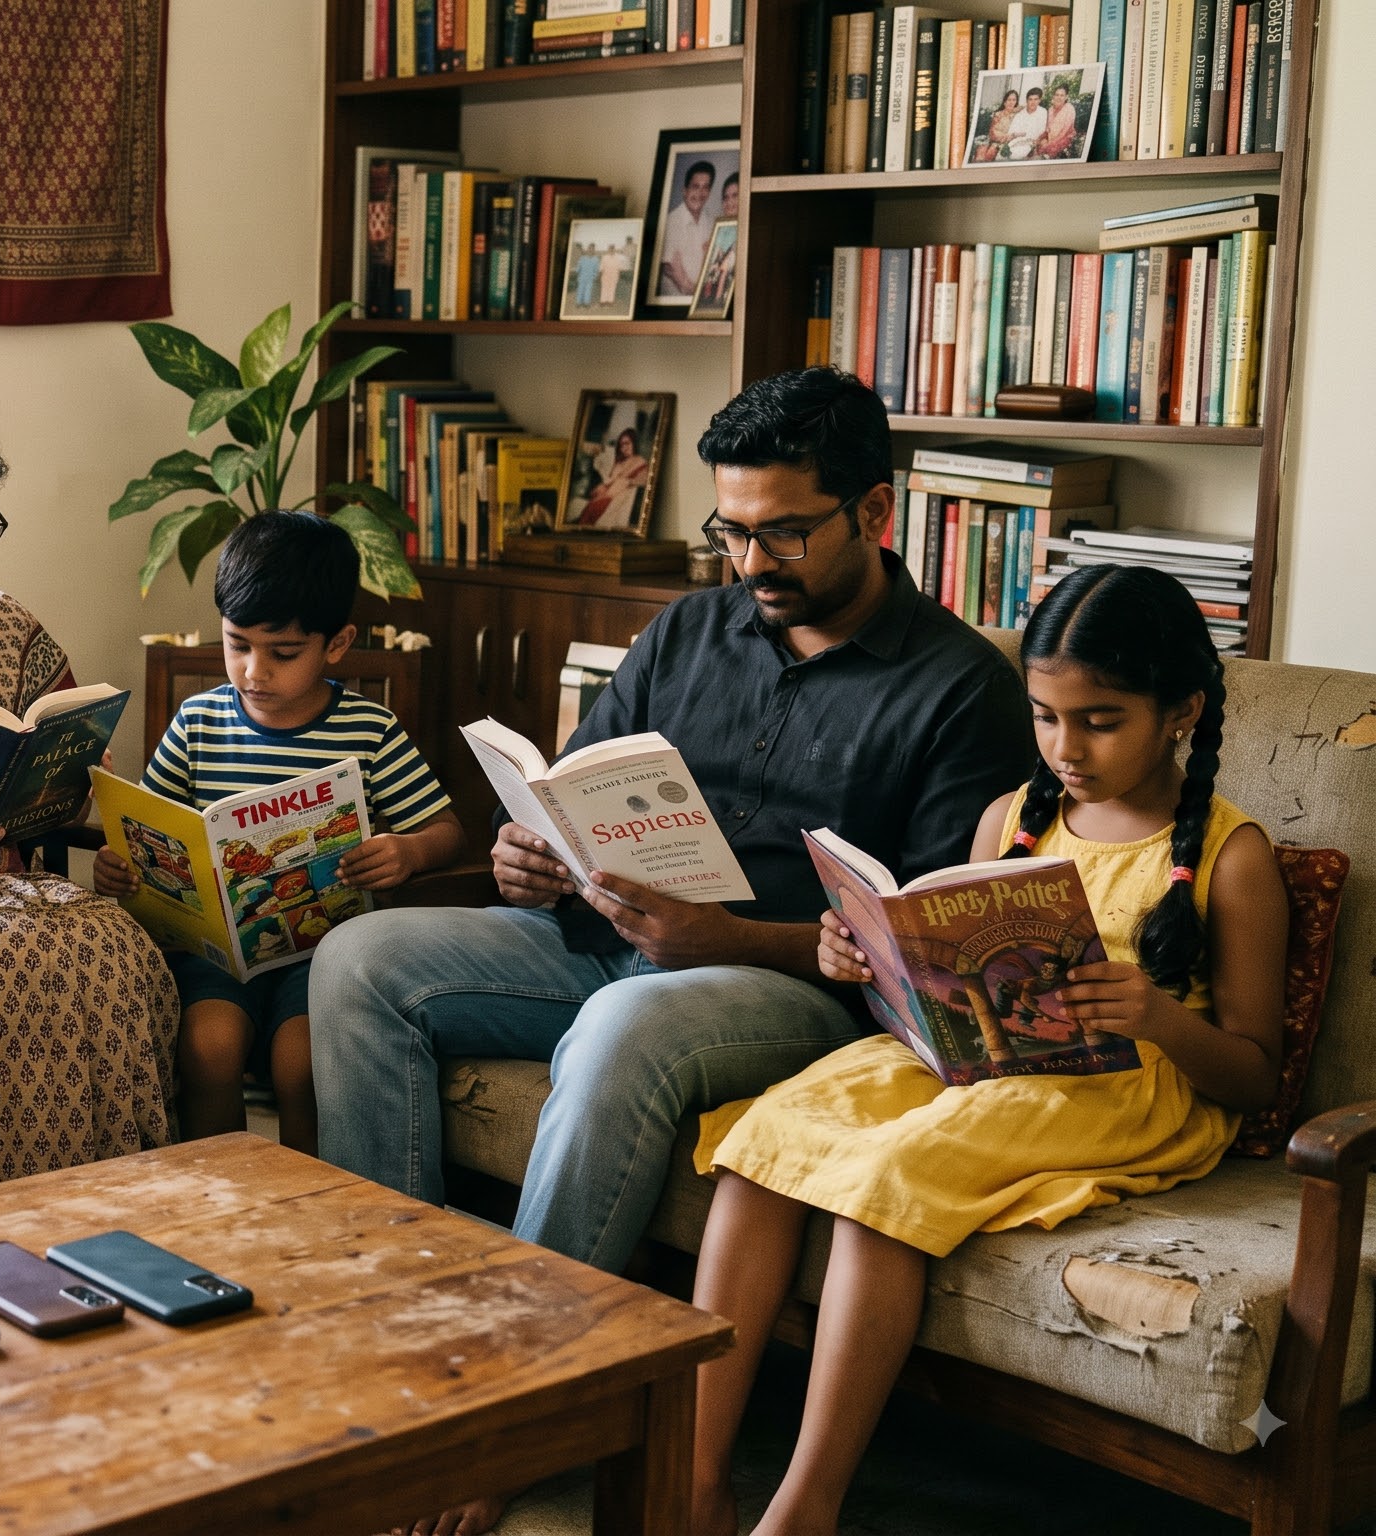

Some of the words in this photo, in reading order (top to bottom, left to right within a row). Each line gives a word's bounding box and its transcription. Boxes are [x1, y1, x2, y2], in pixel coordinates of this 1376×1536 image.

[31, 738, 96, 768] PALACE
[231, 780, 334, 829] TINKLE
[592, 810, 707, 845] Sapiens
[920, 889, 991, 927] Harry
[989, 879, 1073, 919] Potter
